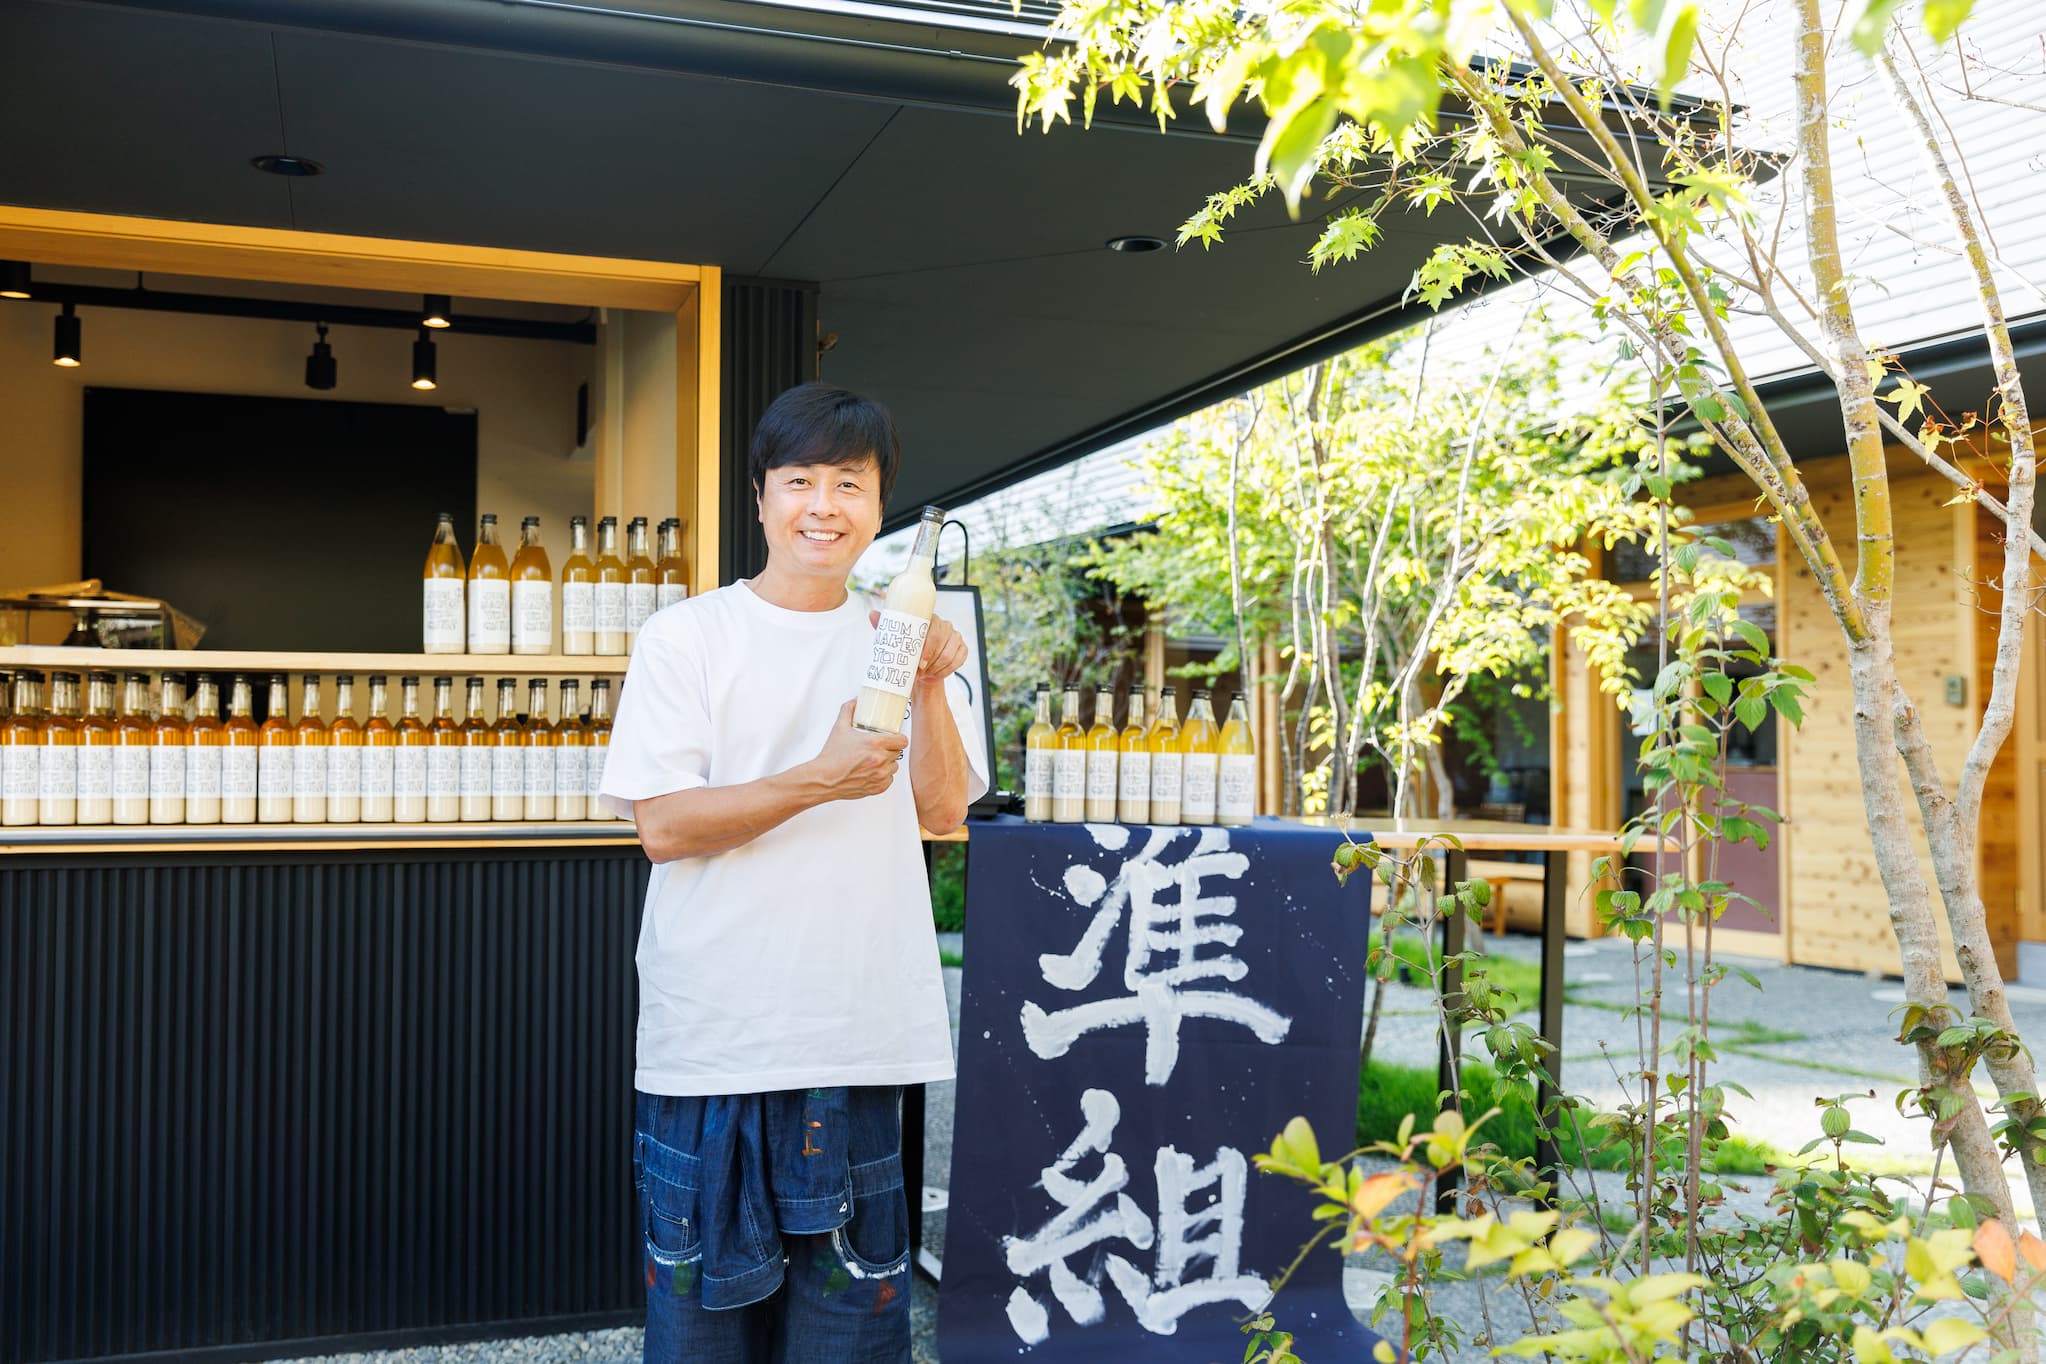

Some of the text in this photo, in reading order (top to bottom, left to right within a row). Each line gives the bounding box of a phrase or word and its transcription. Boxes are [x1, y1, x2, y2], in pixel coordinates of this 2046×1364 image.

[873, 646, 909, 666] YOU
[867, 665, 911, 687] SMILE
[1003, 824, 1290, 1344] 準組
